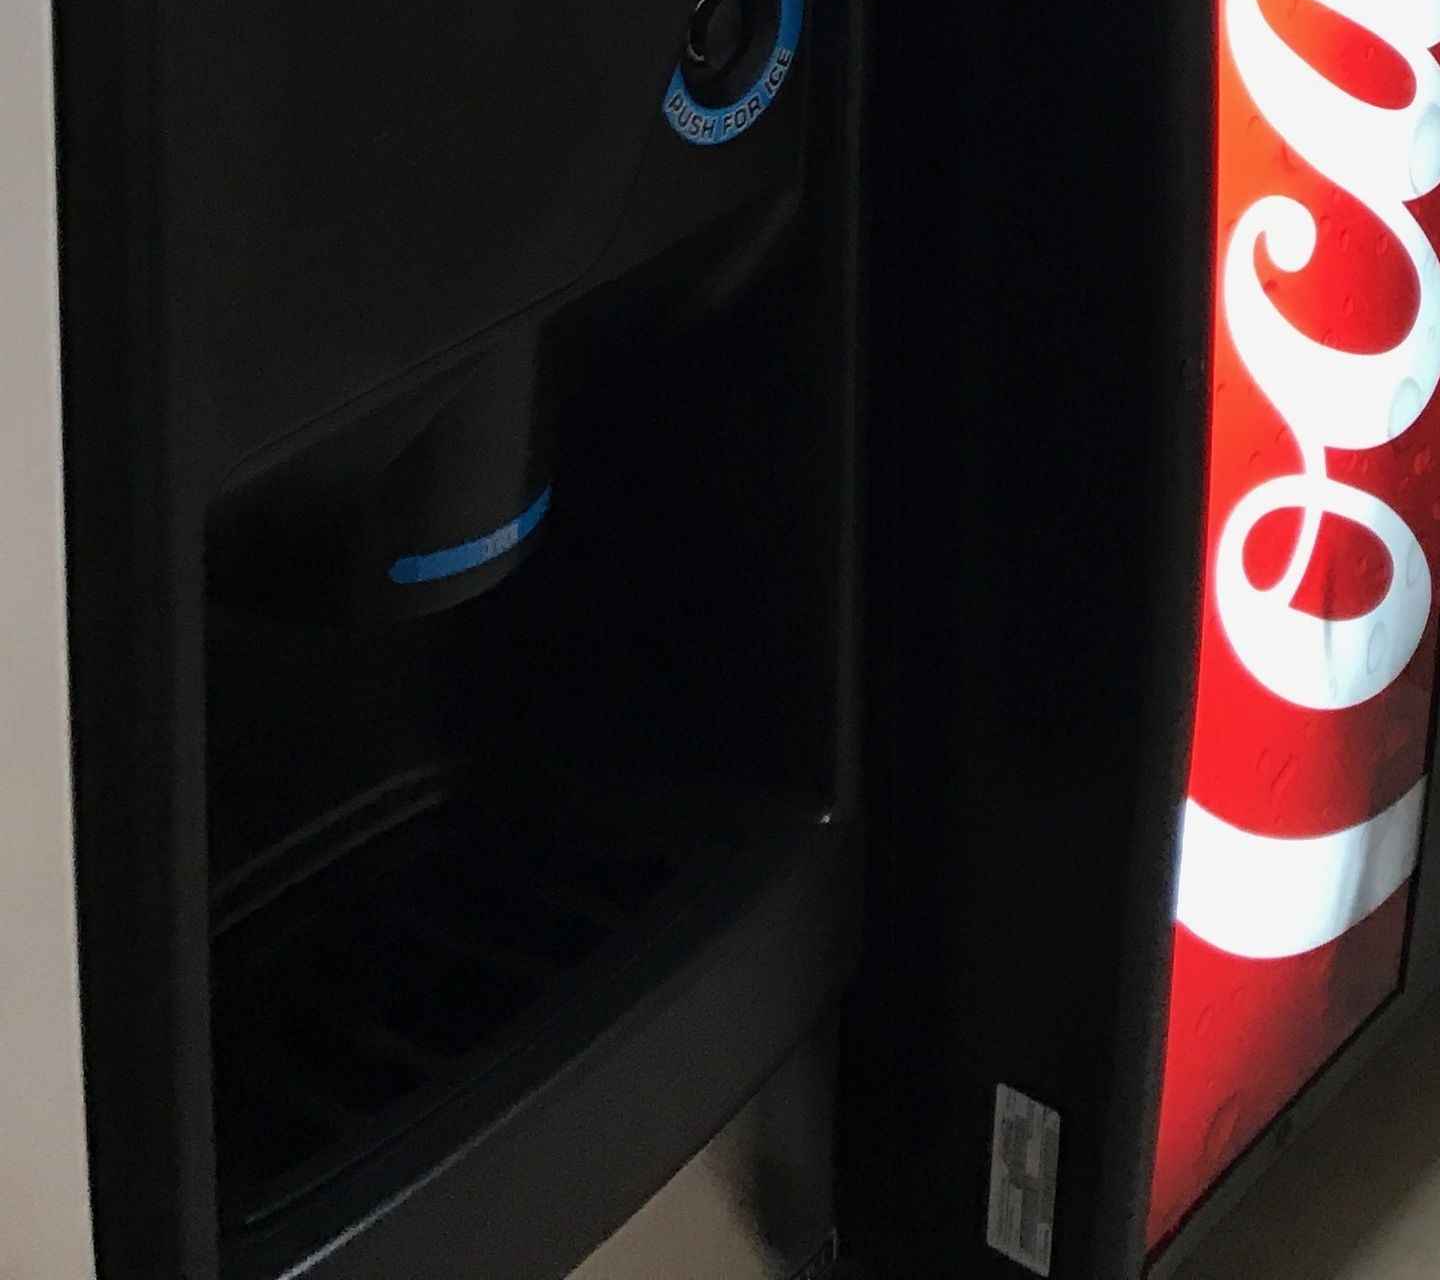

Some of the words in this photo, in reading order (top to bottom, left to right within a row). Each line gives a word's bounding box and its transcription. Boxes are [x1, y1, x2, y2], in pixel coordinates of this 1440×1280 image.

[667, 92, 717, 139] PUSH
[722, 96, 762, 135] FOR
[764, 48, 793, 97] ICE
